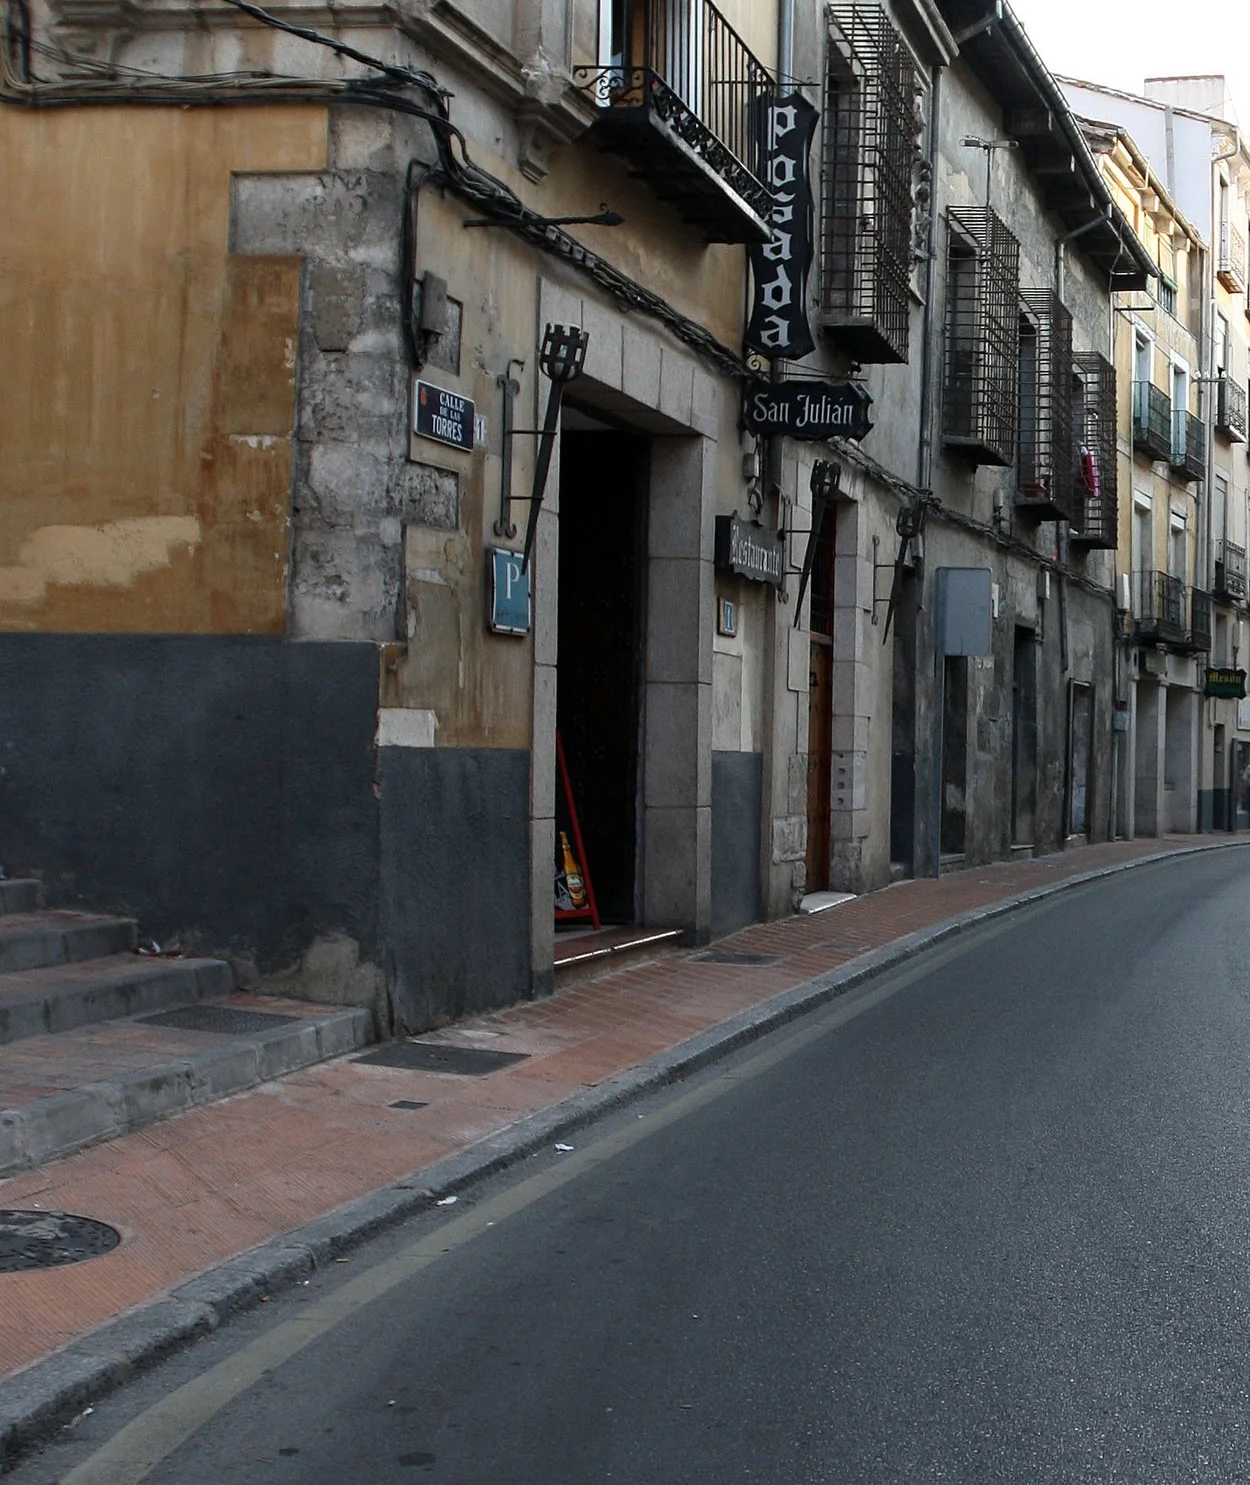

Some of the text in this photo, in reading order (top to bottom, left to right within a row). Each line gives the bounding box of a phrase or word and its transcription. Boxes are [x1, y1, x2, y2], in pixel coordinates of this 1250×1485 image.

[440, 392, 465, 412] CALLE
[440, 407, 461, 421] DE LAS
[753, 393, 854, 427] San Julián
[431, 414, 463, 442] TORRES
[731, 523, 780, 577] Restaurante
[506, 562, 520, 599] P
